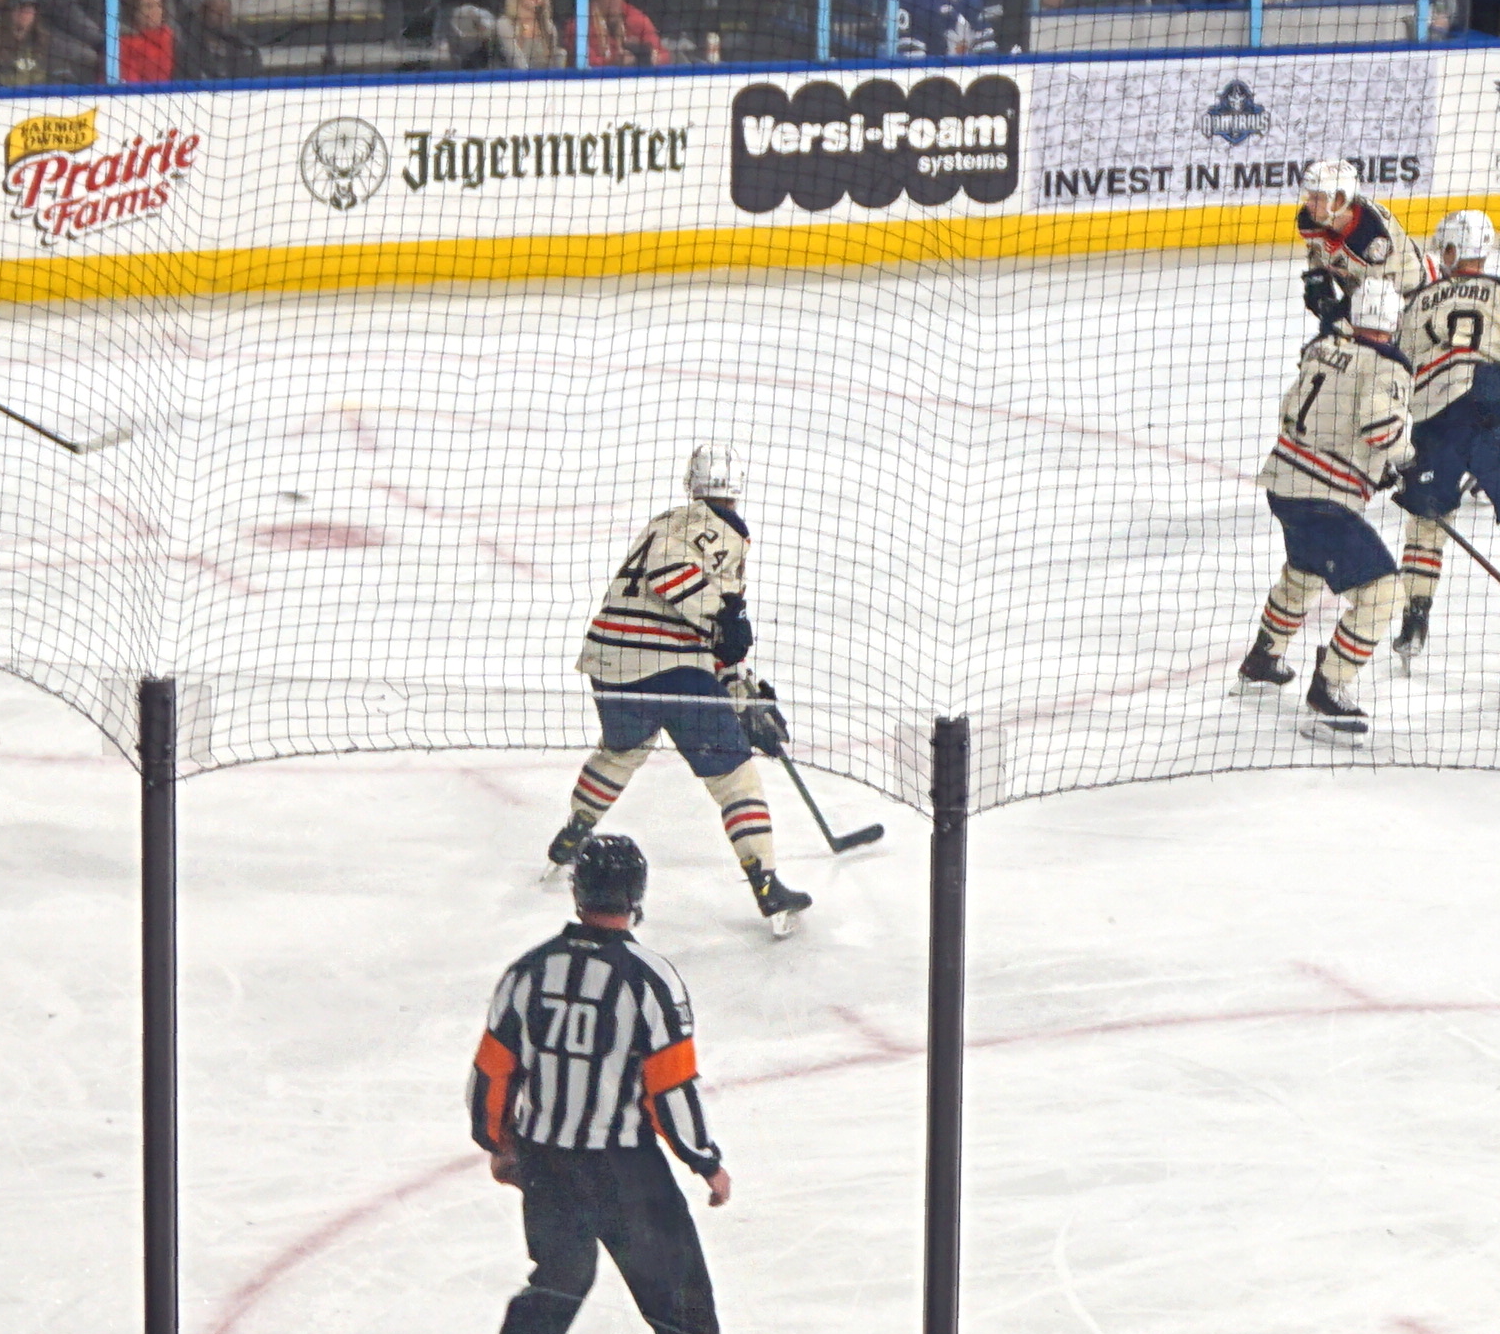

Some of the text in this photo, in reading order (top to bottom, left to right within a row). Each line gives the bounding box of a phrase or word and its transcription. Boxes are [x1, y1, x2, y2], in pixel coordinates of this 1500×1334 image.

[742, 112, 1008, 156] Versi-Foam
[1200, 110, 1271, 139] ADMIRALS
[11, 128, 200, 209] Prairie
[917, 151, 1008, 177] systems
[1044, 154, 1421, 198] INVEST IN MEMRIES
[43, 181, 171, 236] Farms
[1421, 284, 1490, 312] SANFORD
[693, 528, 729, 572] 24
[539, 997, 598, 1056] 70
